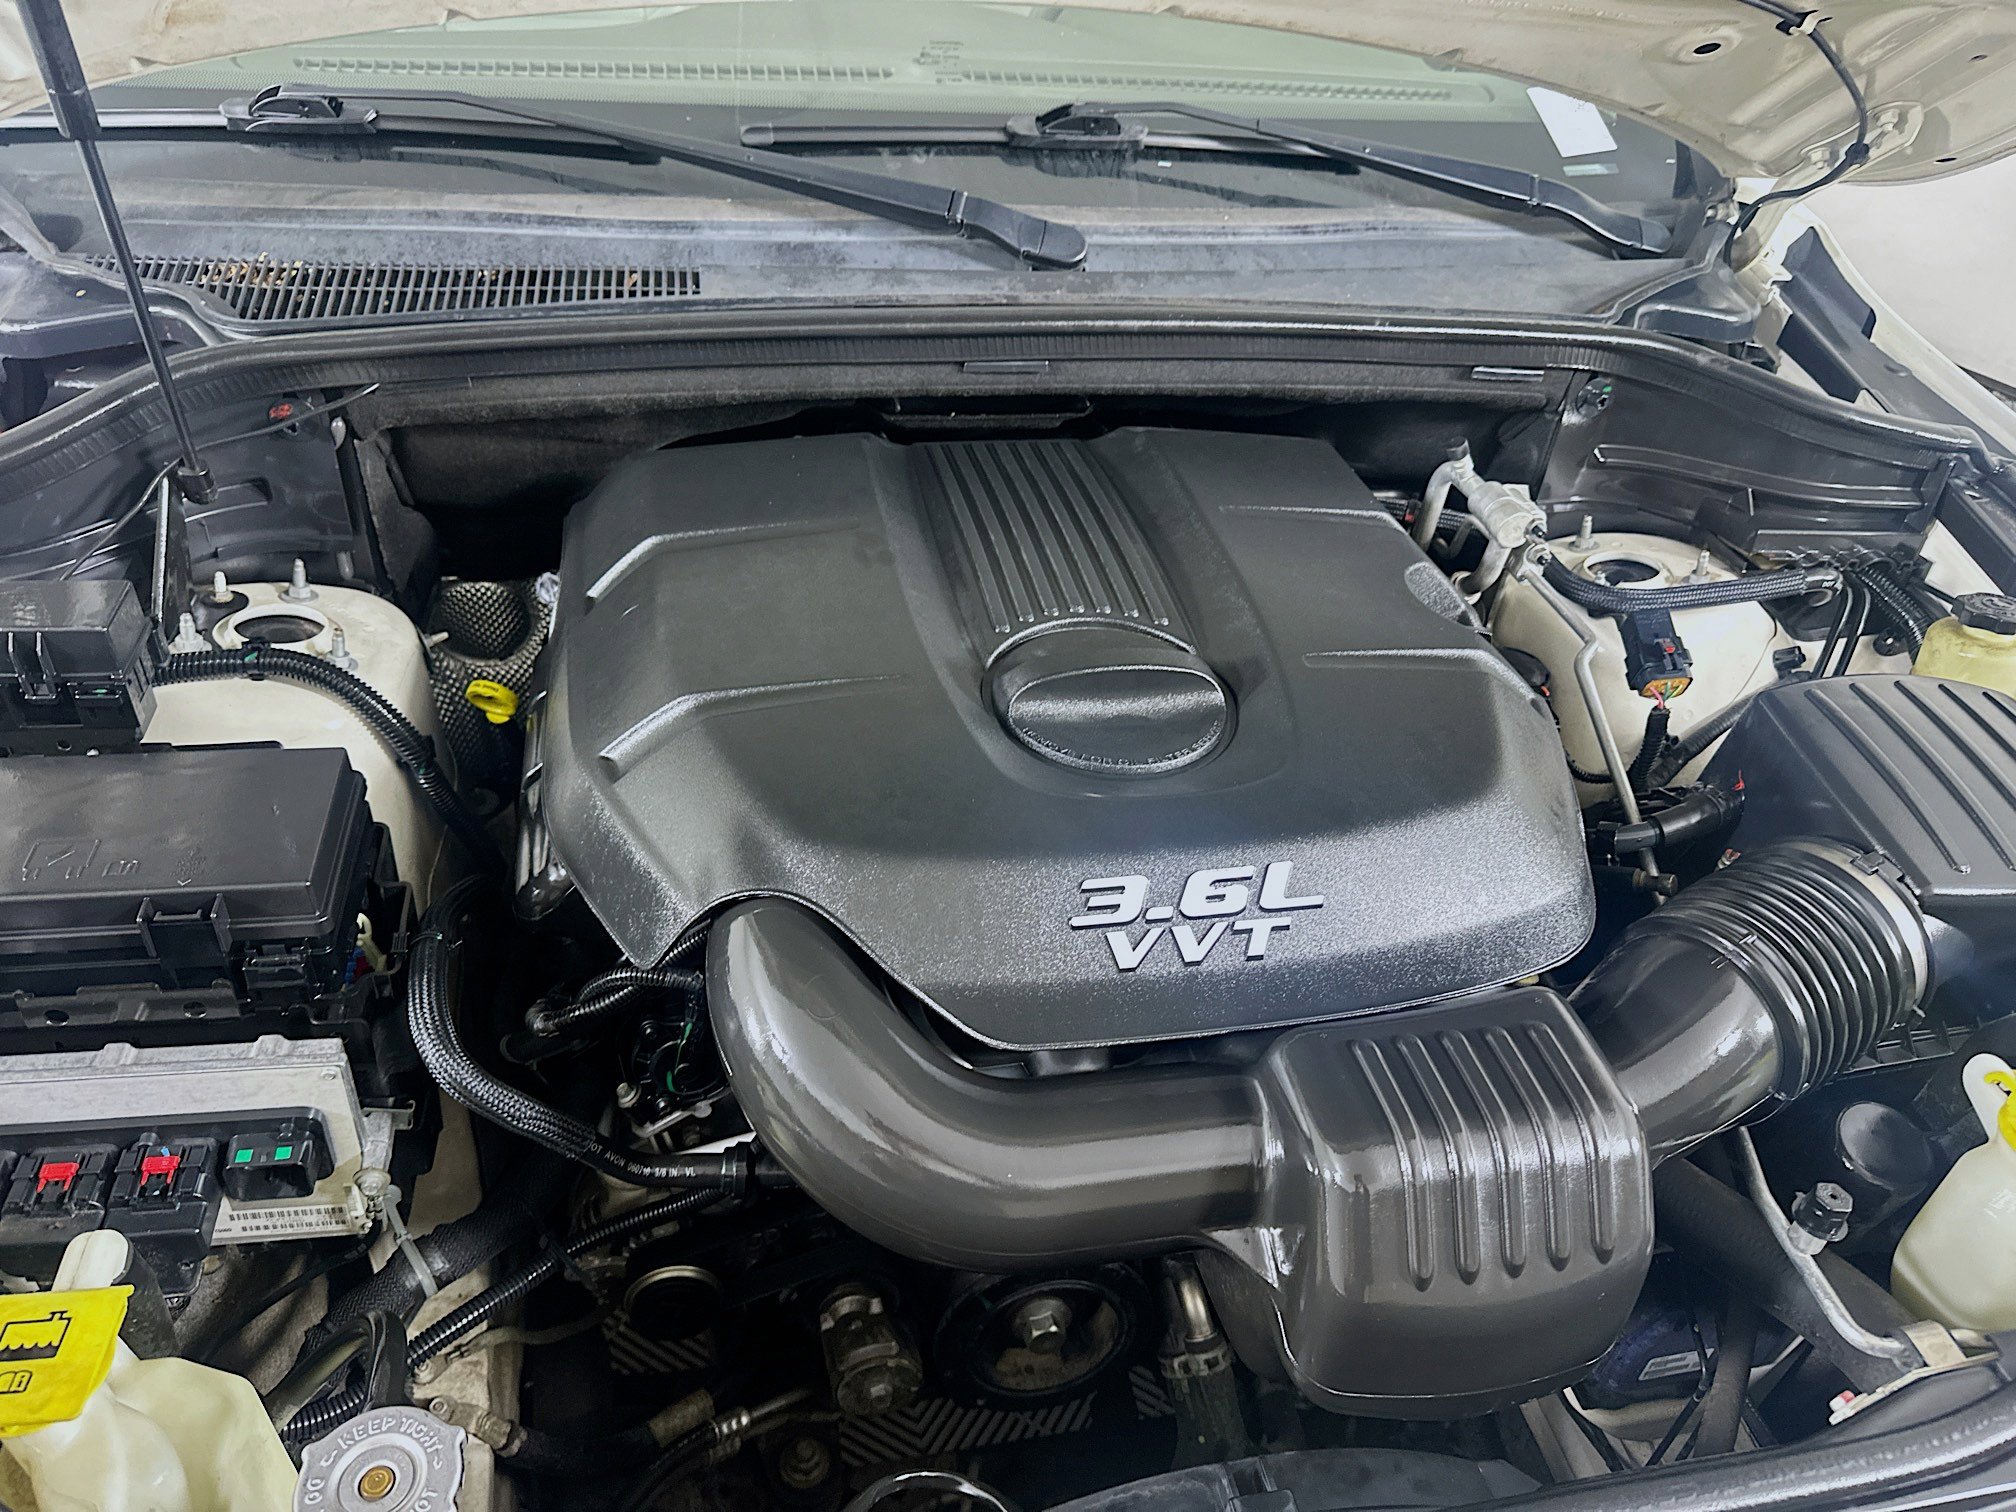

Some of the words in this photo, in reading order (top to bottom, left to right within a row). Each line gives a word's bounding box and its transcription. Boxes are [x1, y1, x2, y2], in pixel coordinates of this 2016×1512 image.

[1068, 860, 1325, 930] 3.6L
[1105, 916, 1292, 972] VVT
[604, 1150, 626, 1167] AVON
[336, 1416, 397, 1450] KEEP
[399, 1416, 444, 1454] TIGHT
